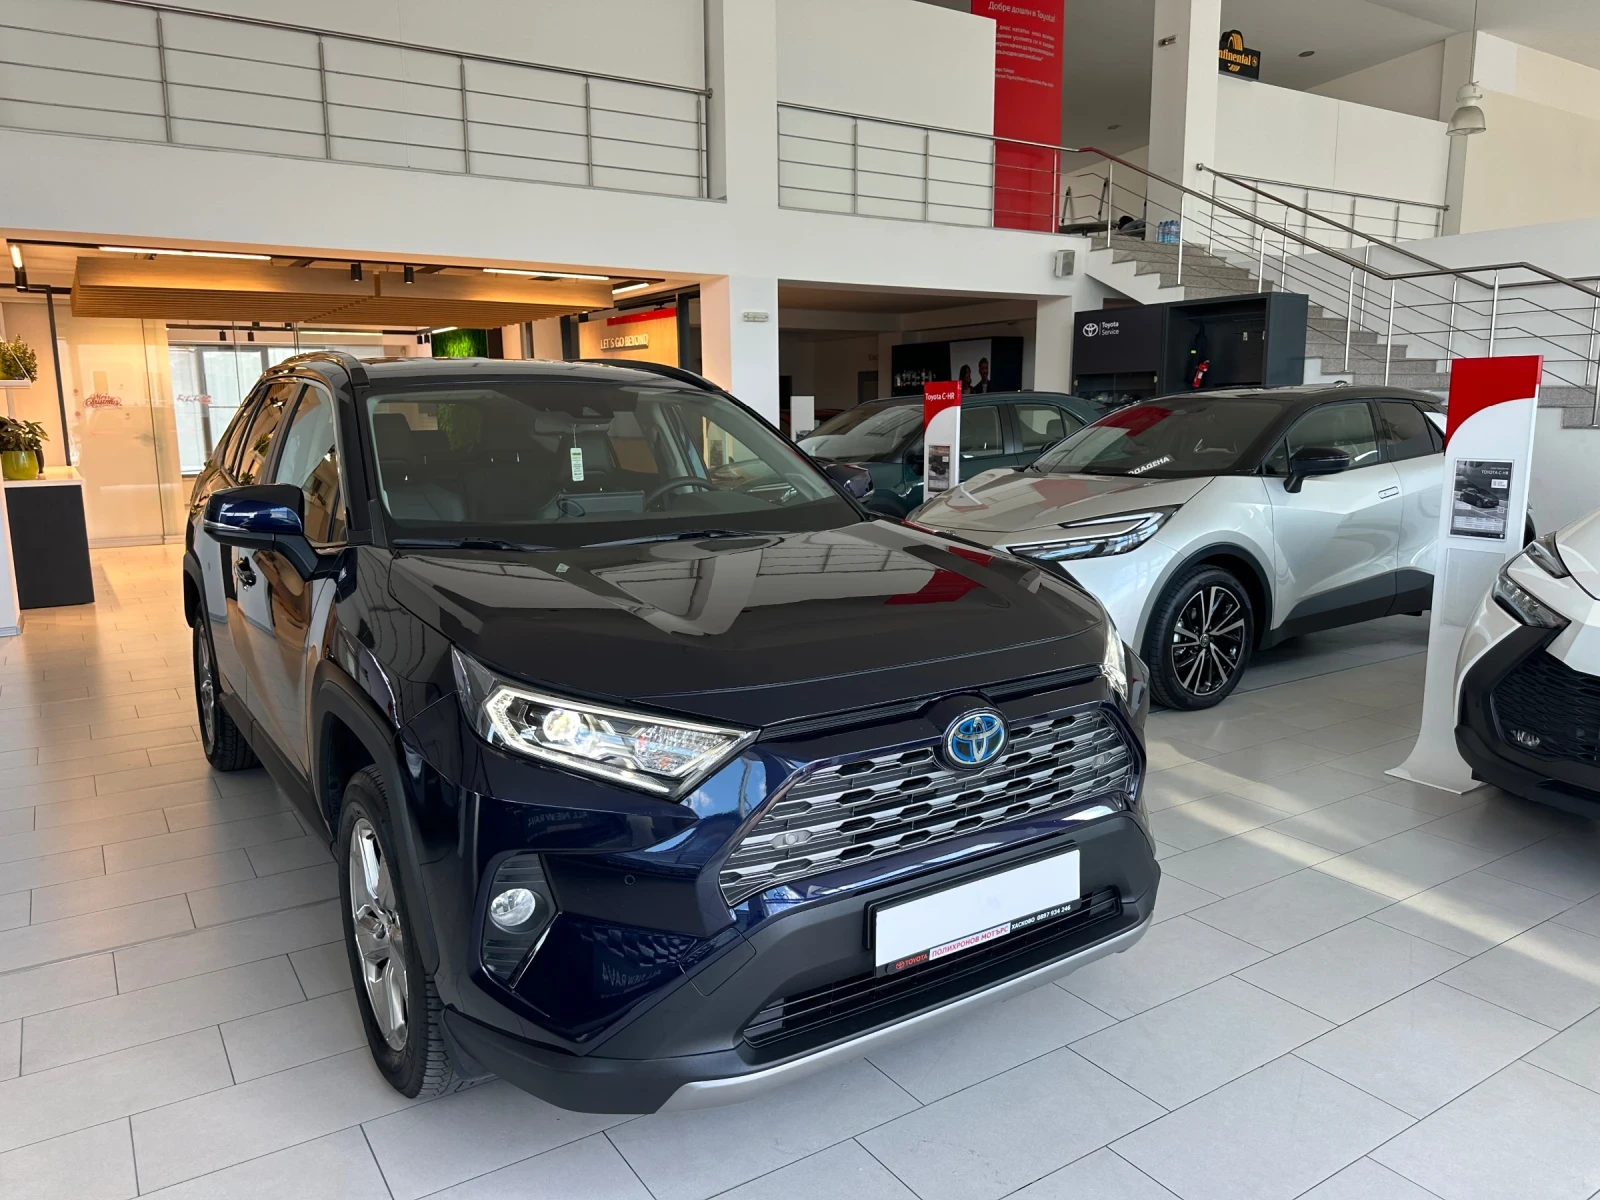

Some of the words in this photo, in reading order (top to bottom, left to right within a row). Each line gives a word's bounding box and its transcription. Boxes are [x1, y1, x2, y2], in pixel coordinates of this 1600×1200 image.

[988, 1, 1011, 12] Добре
[1011, 6, 1032, 16] дошли
[1218, 49, 1251, 65] ntinental
[1101, 321, 1119, 329] Toyota
[615, 337, 624, 348] GO
[625, 333, 649, 347] BEYOND
[925, 393, 942, 402] Toyota
[941, 392, 955, 400] C-HR
[905, 953, 928, 966] TOYOTA
[932, 935, 980, 958] ПОЛИХРОНОВ
[980, 925, 1008, 940] МОТЪРС
